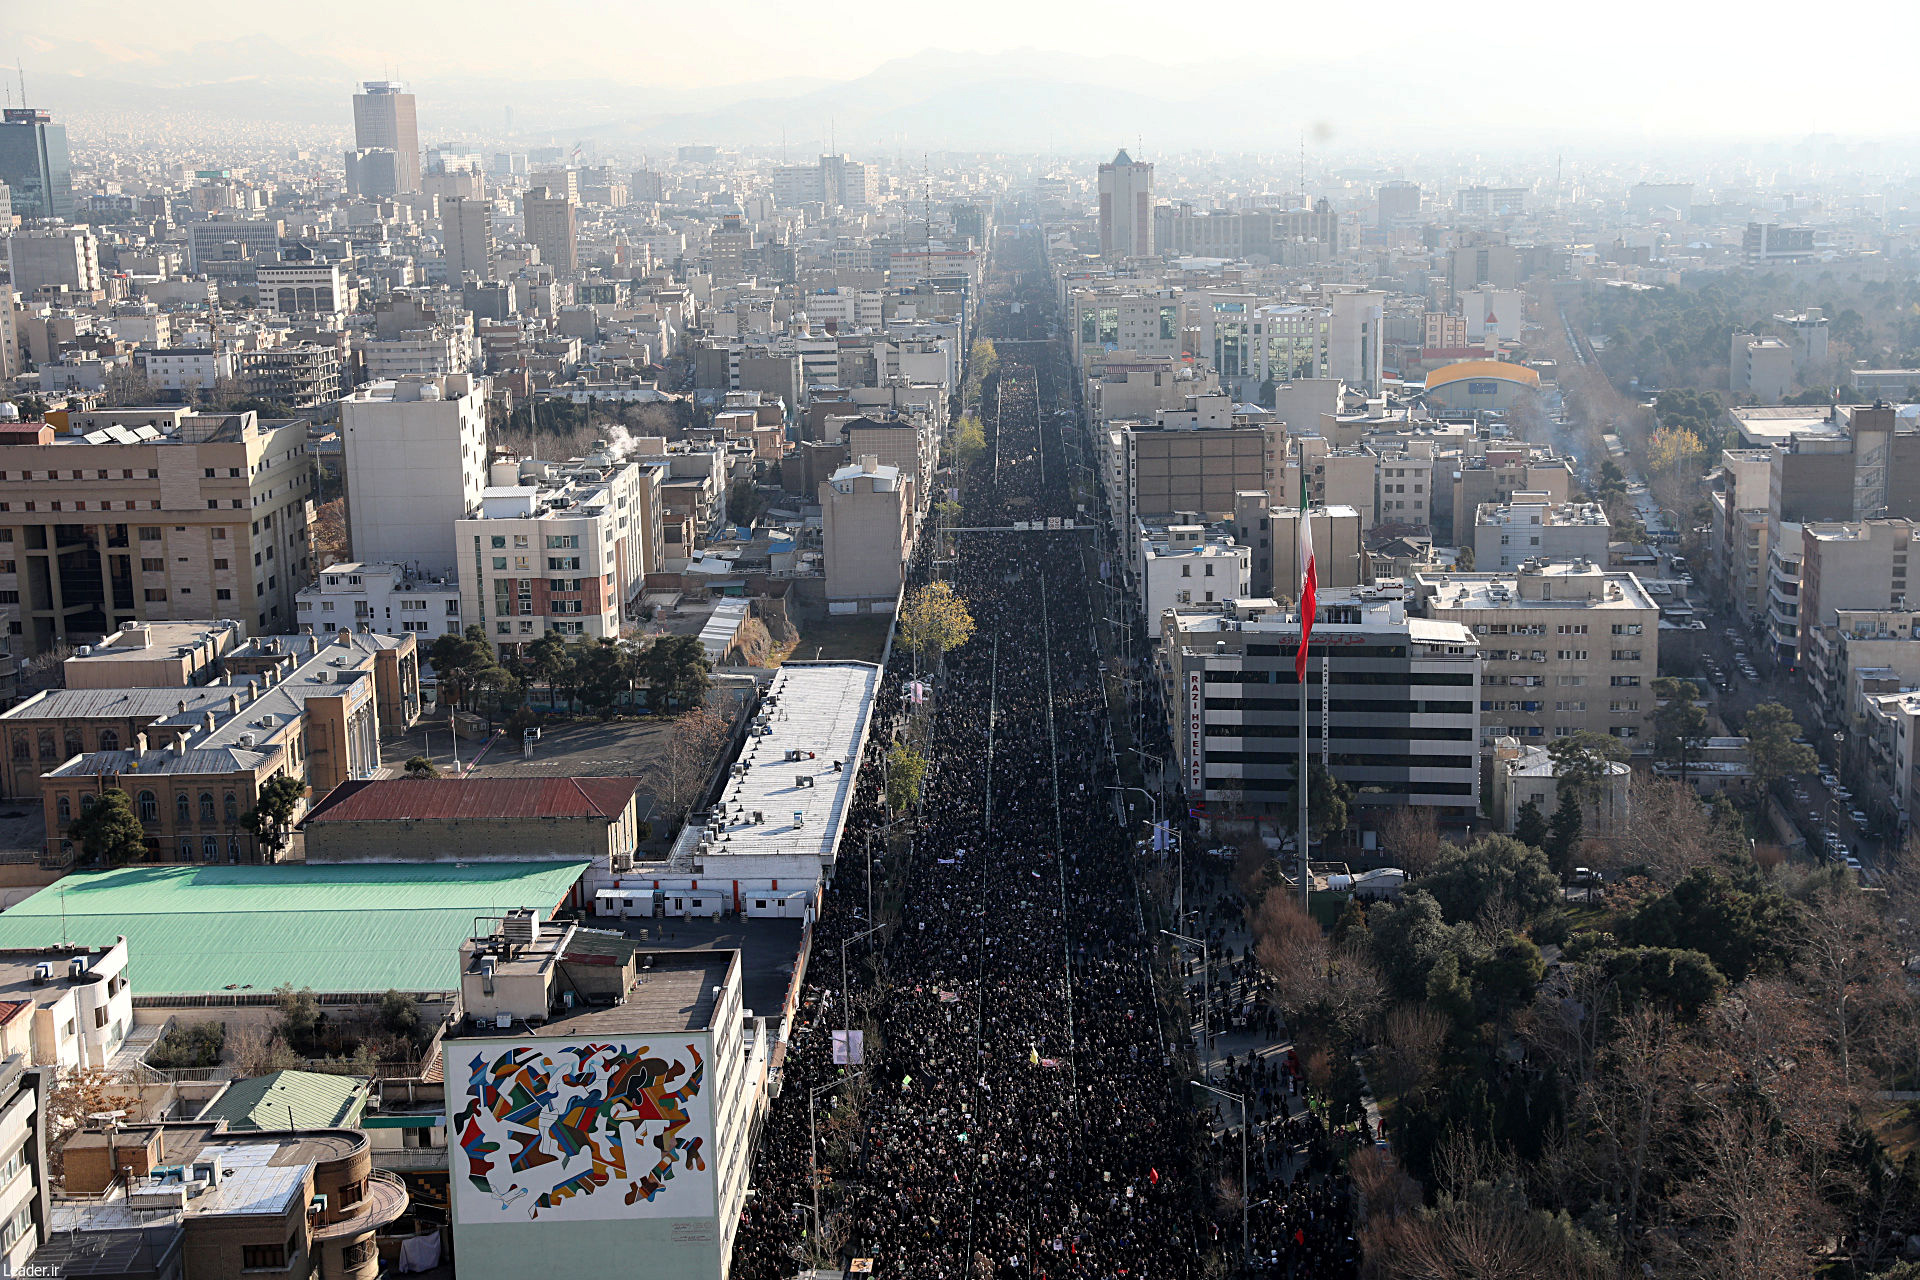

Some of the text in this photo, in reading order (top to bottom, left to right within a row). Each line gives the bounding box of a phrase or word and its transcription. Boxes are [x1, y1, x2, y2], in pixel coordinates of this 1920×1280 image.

[1377, 583, 1403, 592] هتل
[1344, 635, 1366, 645] هتل
[1191, 675, 1199, 709] RAZI
[1192, 760, 1200, 785] APT
